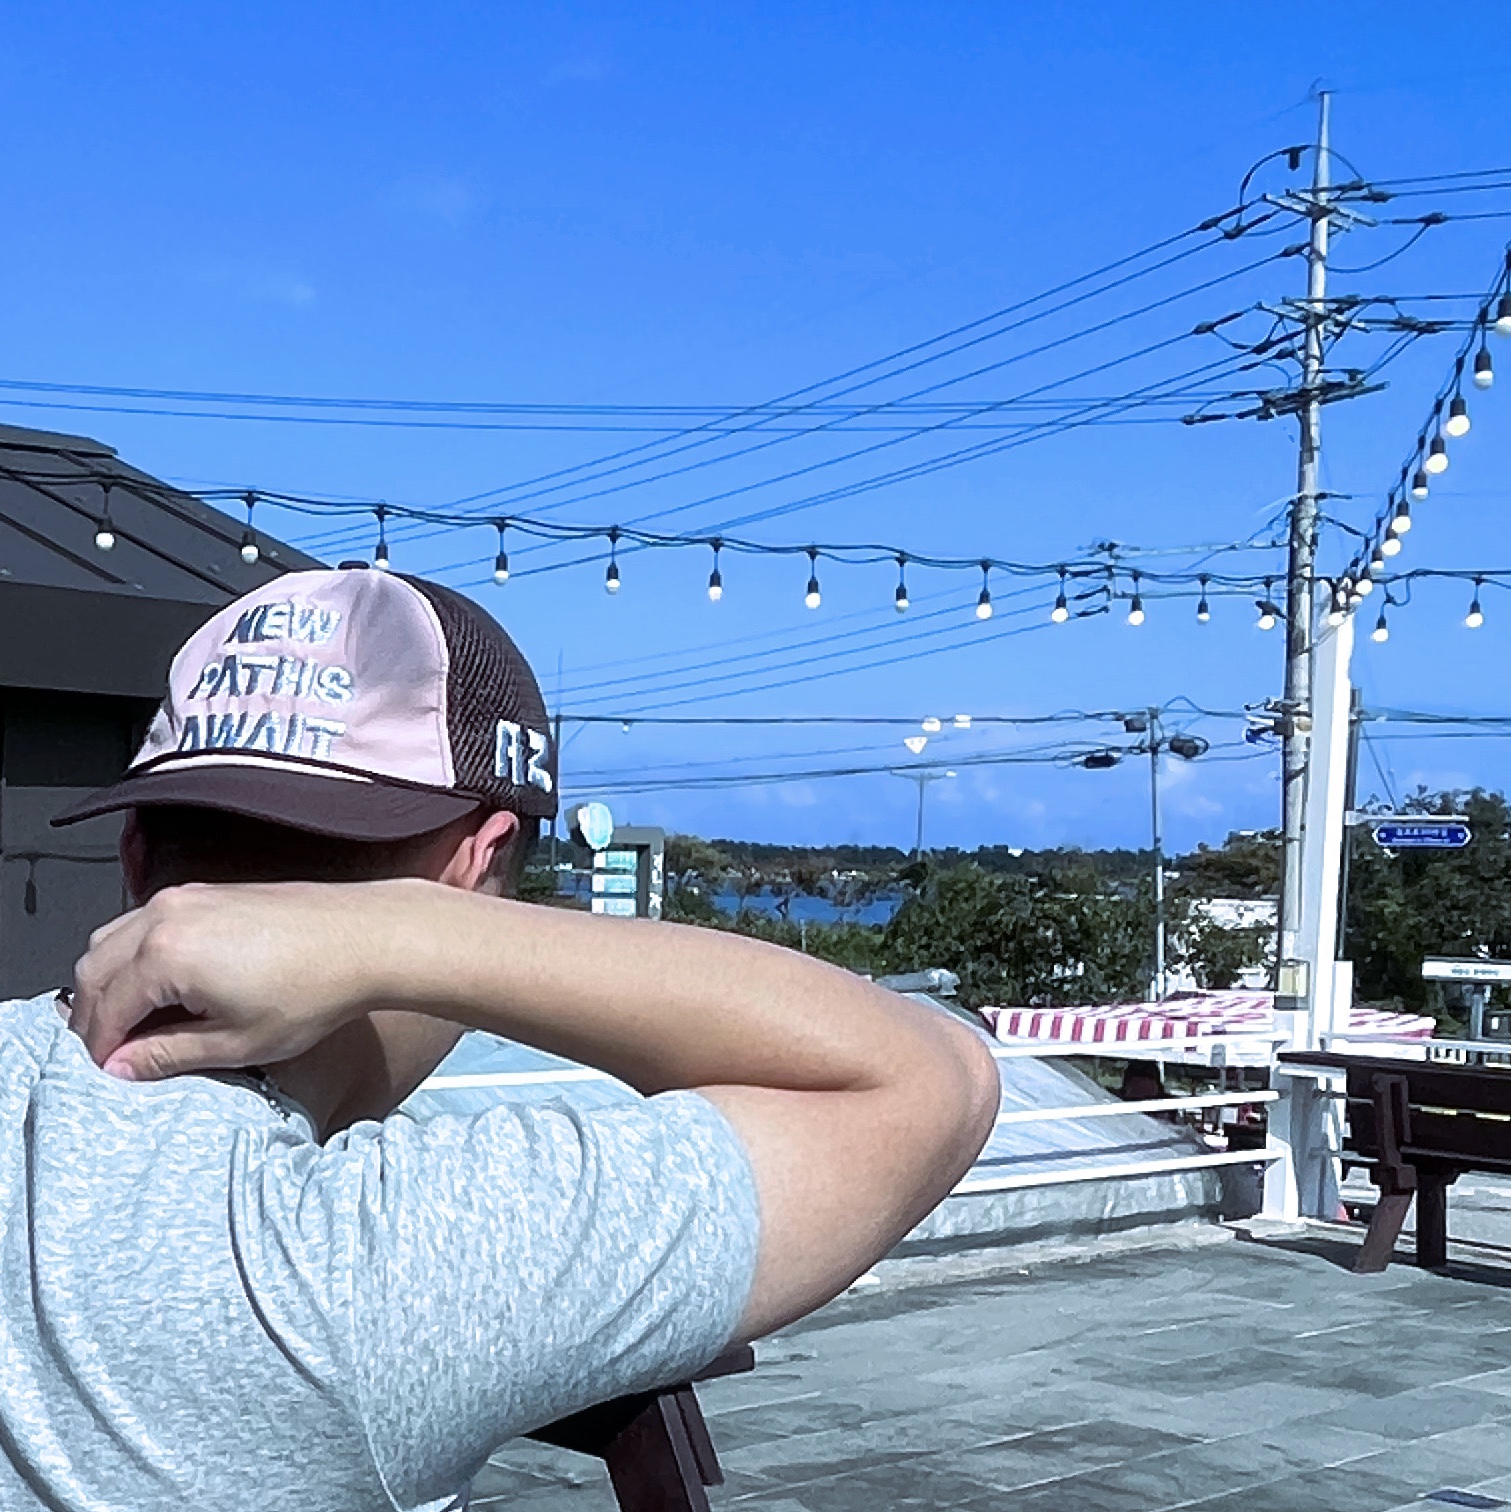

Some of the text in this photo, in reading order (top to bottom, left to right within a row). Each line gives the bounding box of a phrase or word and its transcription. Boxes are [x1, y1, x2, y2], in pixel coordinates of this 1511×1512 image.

[223, 601, 342, 645] NEW
[186, 654, 355, 703] PATHS
[177, 711, 347, 758] AWAIT
